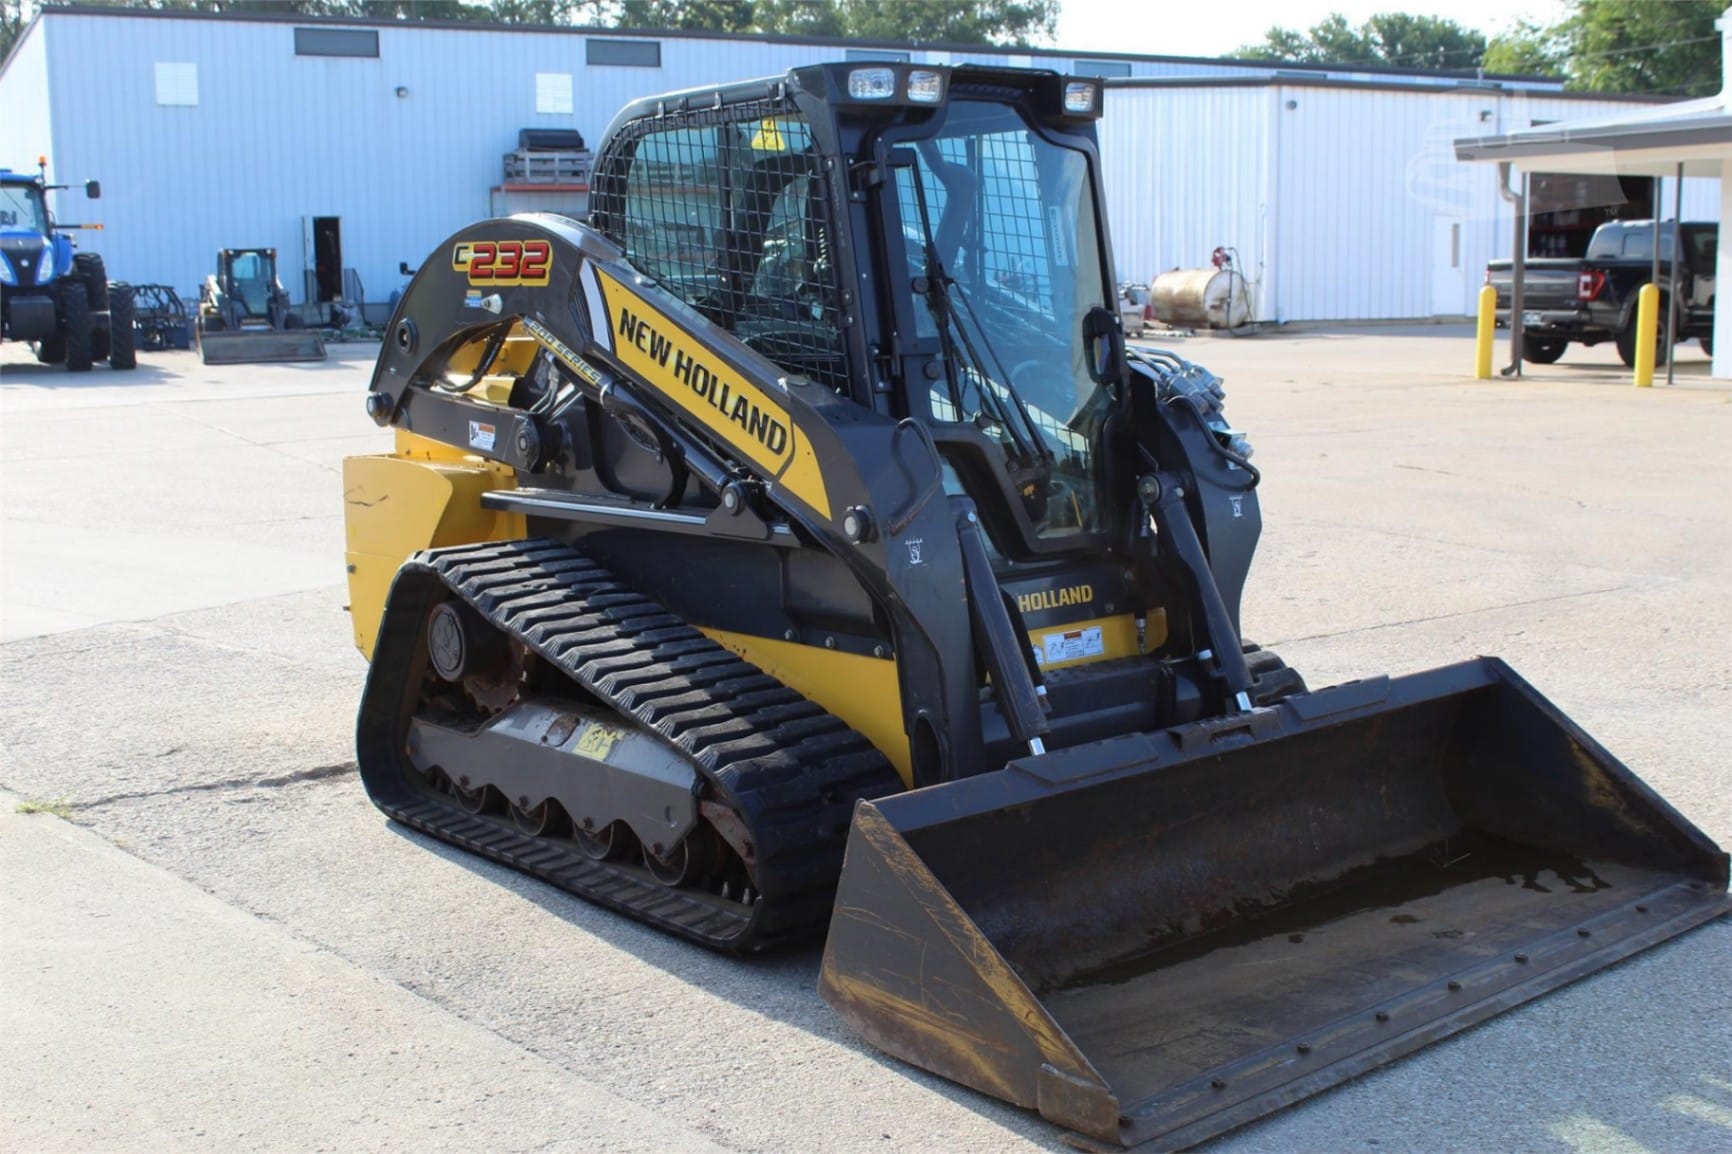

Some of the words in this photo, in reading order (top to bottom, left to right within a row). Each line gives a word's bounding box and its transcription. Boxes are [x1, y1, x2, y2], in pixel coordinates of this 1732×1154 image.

[529, 321, 556, 345] 200
[555, 343, 600, 384] SERIES
[618, 308, 673, 367] NEW
[673, 349, 787, 455] HOLLAND
[1018, 585, 1093, 612] HOLLAND
